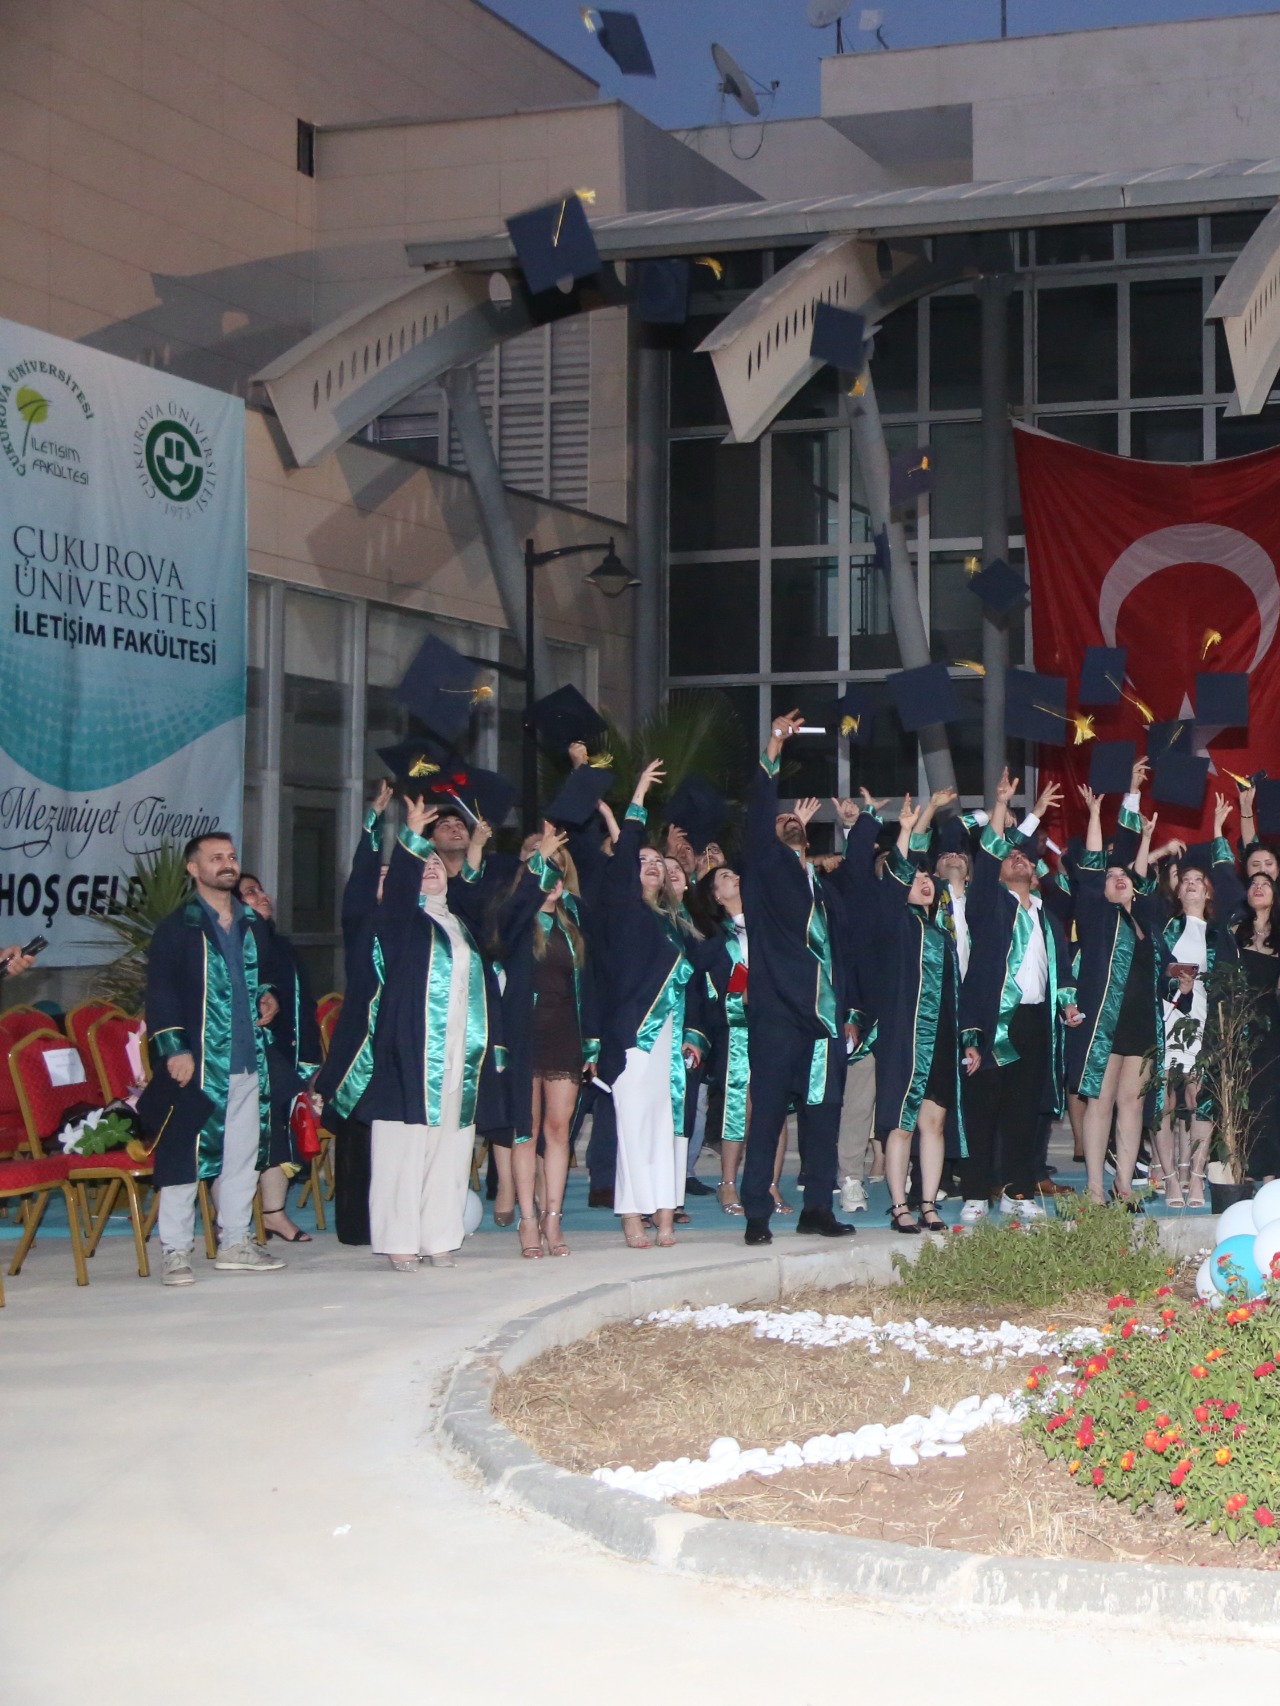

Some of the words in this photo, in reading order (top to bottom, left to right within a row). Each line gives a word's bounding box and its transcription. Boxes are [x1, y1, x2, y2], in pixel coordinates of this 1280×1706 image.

[13, 525, 184, 590] ÇUKUROVA
[15, 564, 217, 632] ÜNİVERSİTESİ
[15, 603, 106, 649] İLETİŞİM
[113, 629, 217, 665] FAKÜLTESİ
[0, 786, 121, 859] Mezuniyet
[0, 872, 61, 928] HOŞ
